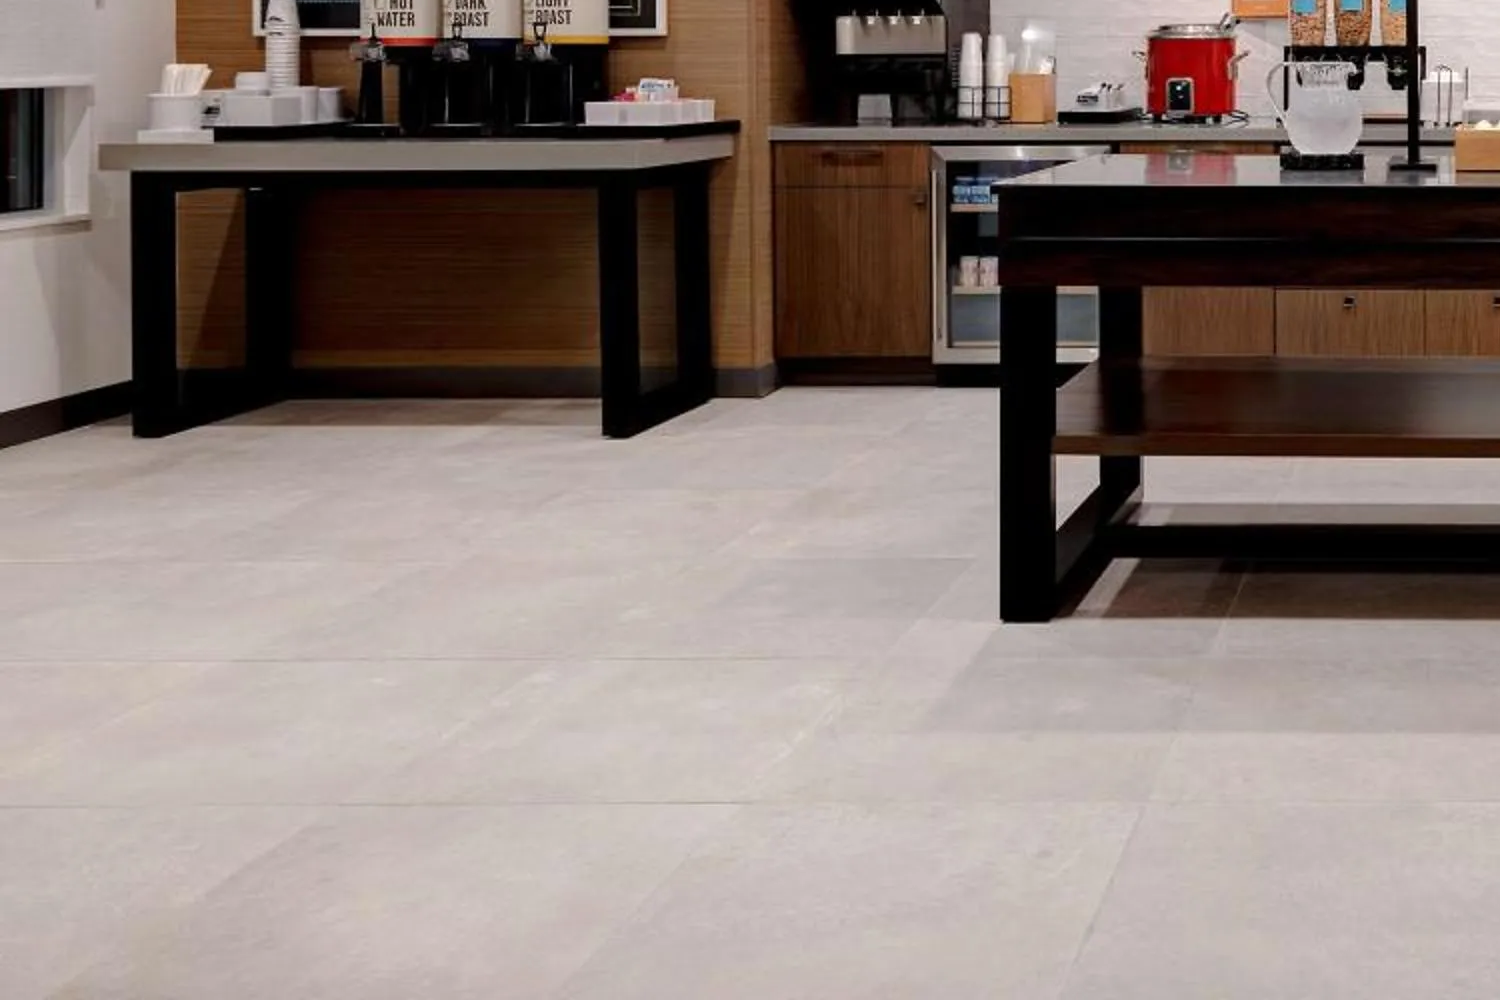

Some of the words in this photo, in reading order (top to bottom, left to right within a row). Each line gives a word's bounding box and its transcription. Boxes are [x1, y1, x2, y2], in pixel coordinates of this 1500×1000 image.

[377, 11, 416, 27] WATER
[453, 11, 489, 27] ROAST
[535, 9, 573, 25] ROAST
